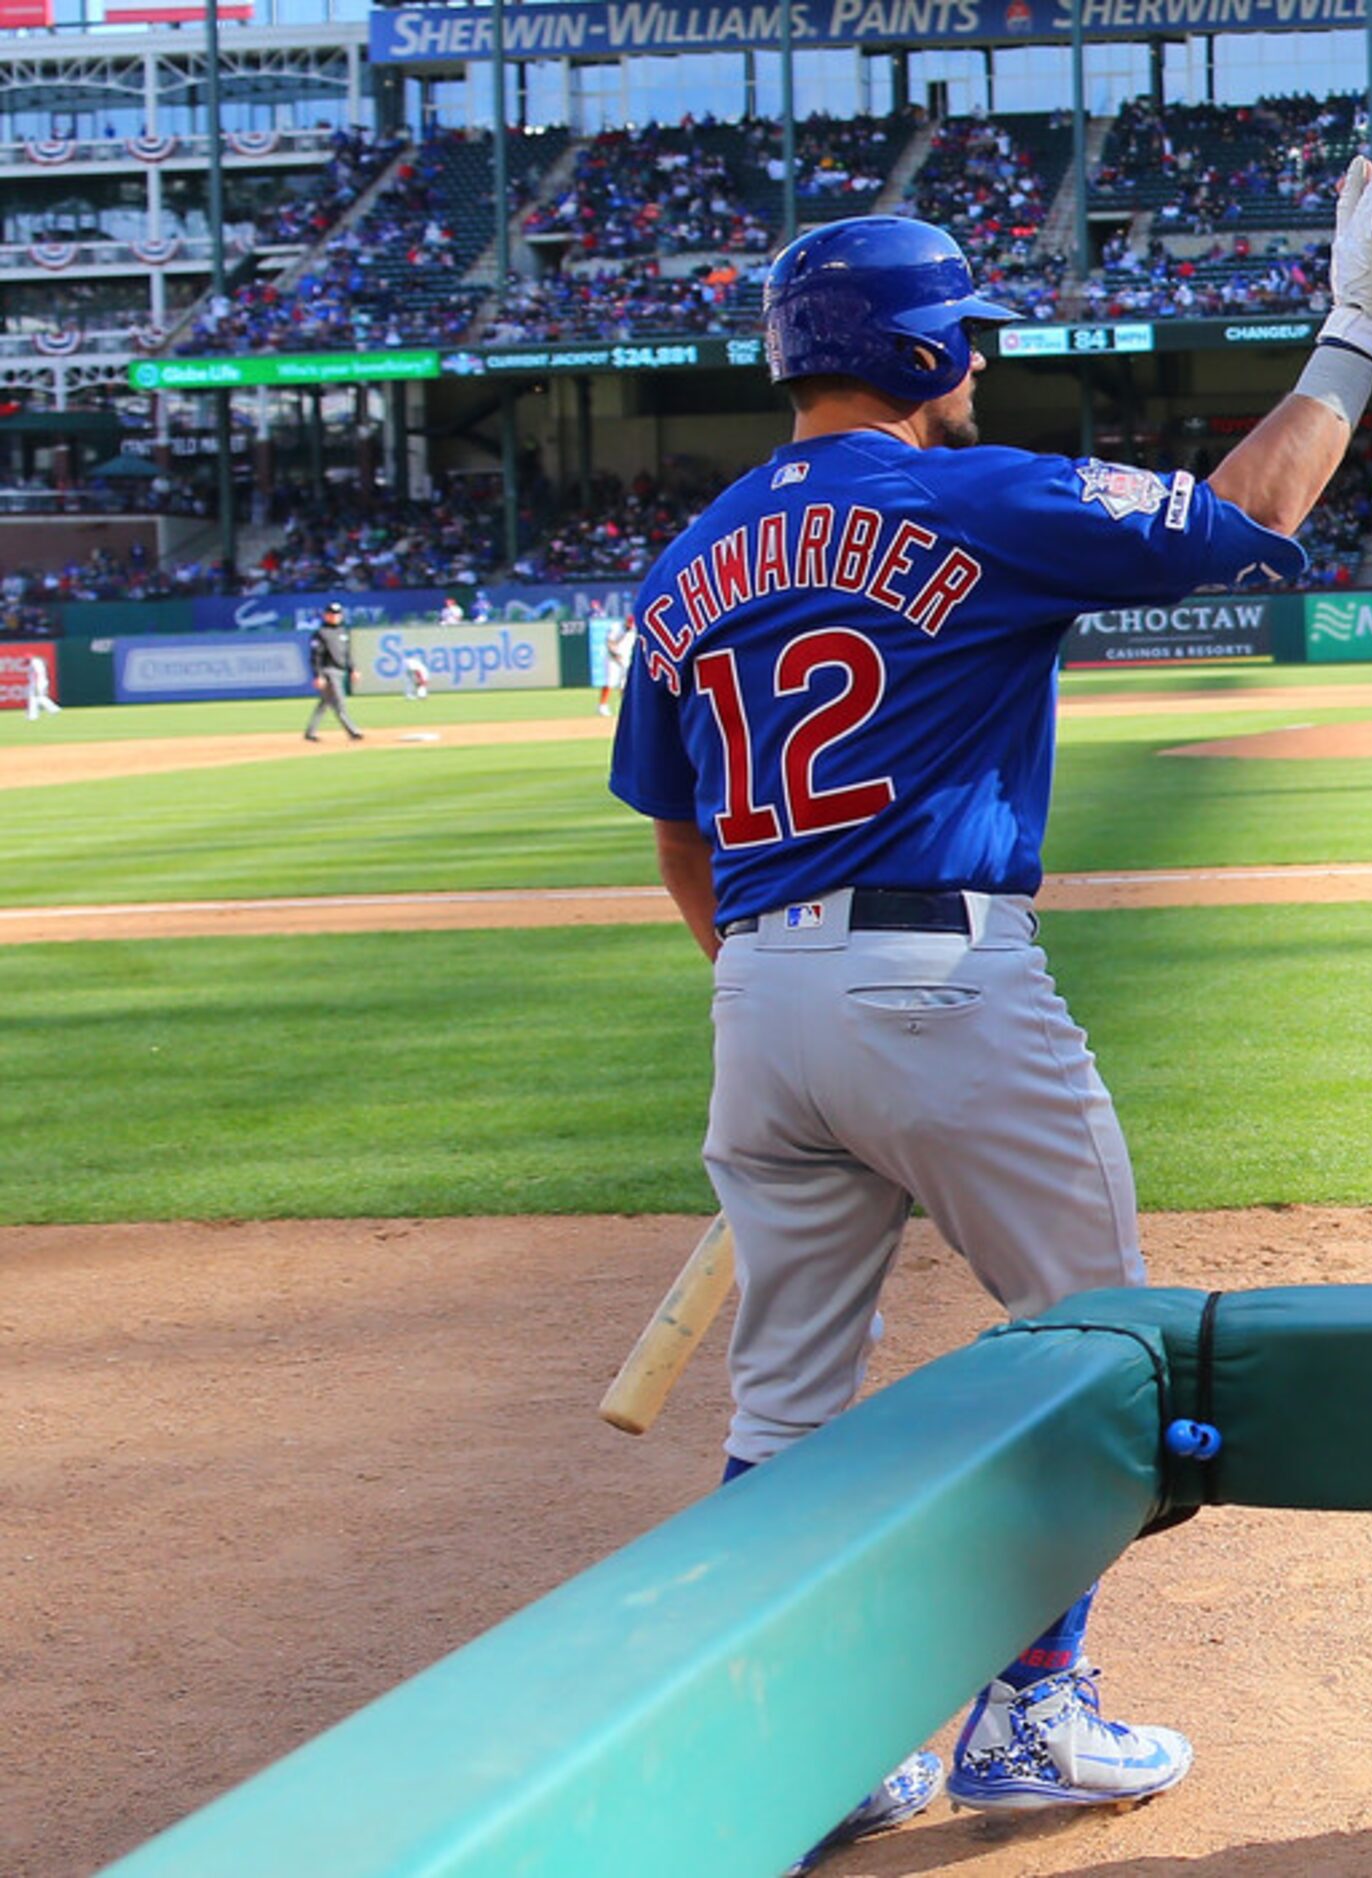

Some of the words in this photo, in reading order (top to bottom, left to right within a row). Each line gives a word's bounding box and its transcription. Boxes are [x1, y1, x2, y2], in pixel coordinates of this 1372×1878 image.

[830, 0, 980, 37] PAINTS
[1074, 331, 1106, 350] 84
[1225, 325, 1311, 340] CHANGEUP
[638, 502, 982, 696] SCHWARBER
[1096, 605, 1264, 634] CHOCTAW
[1105, 647, 1171, 660] CASINOS
[1188, 644, 1253, 657] RESORTS
[694, 625, 896, 851] 12
